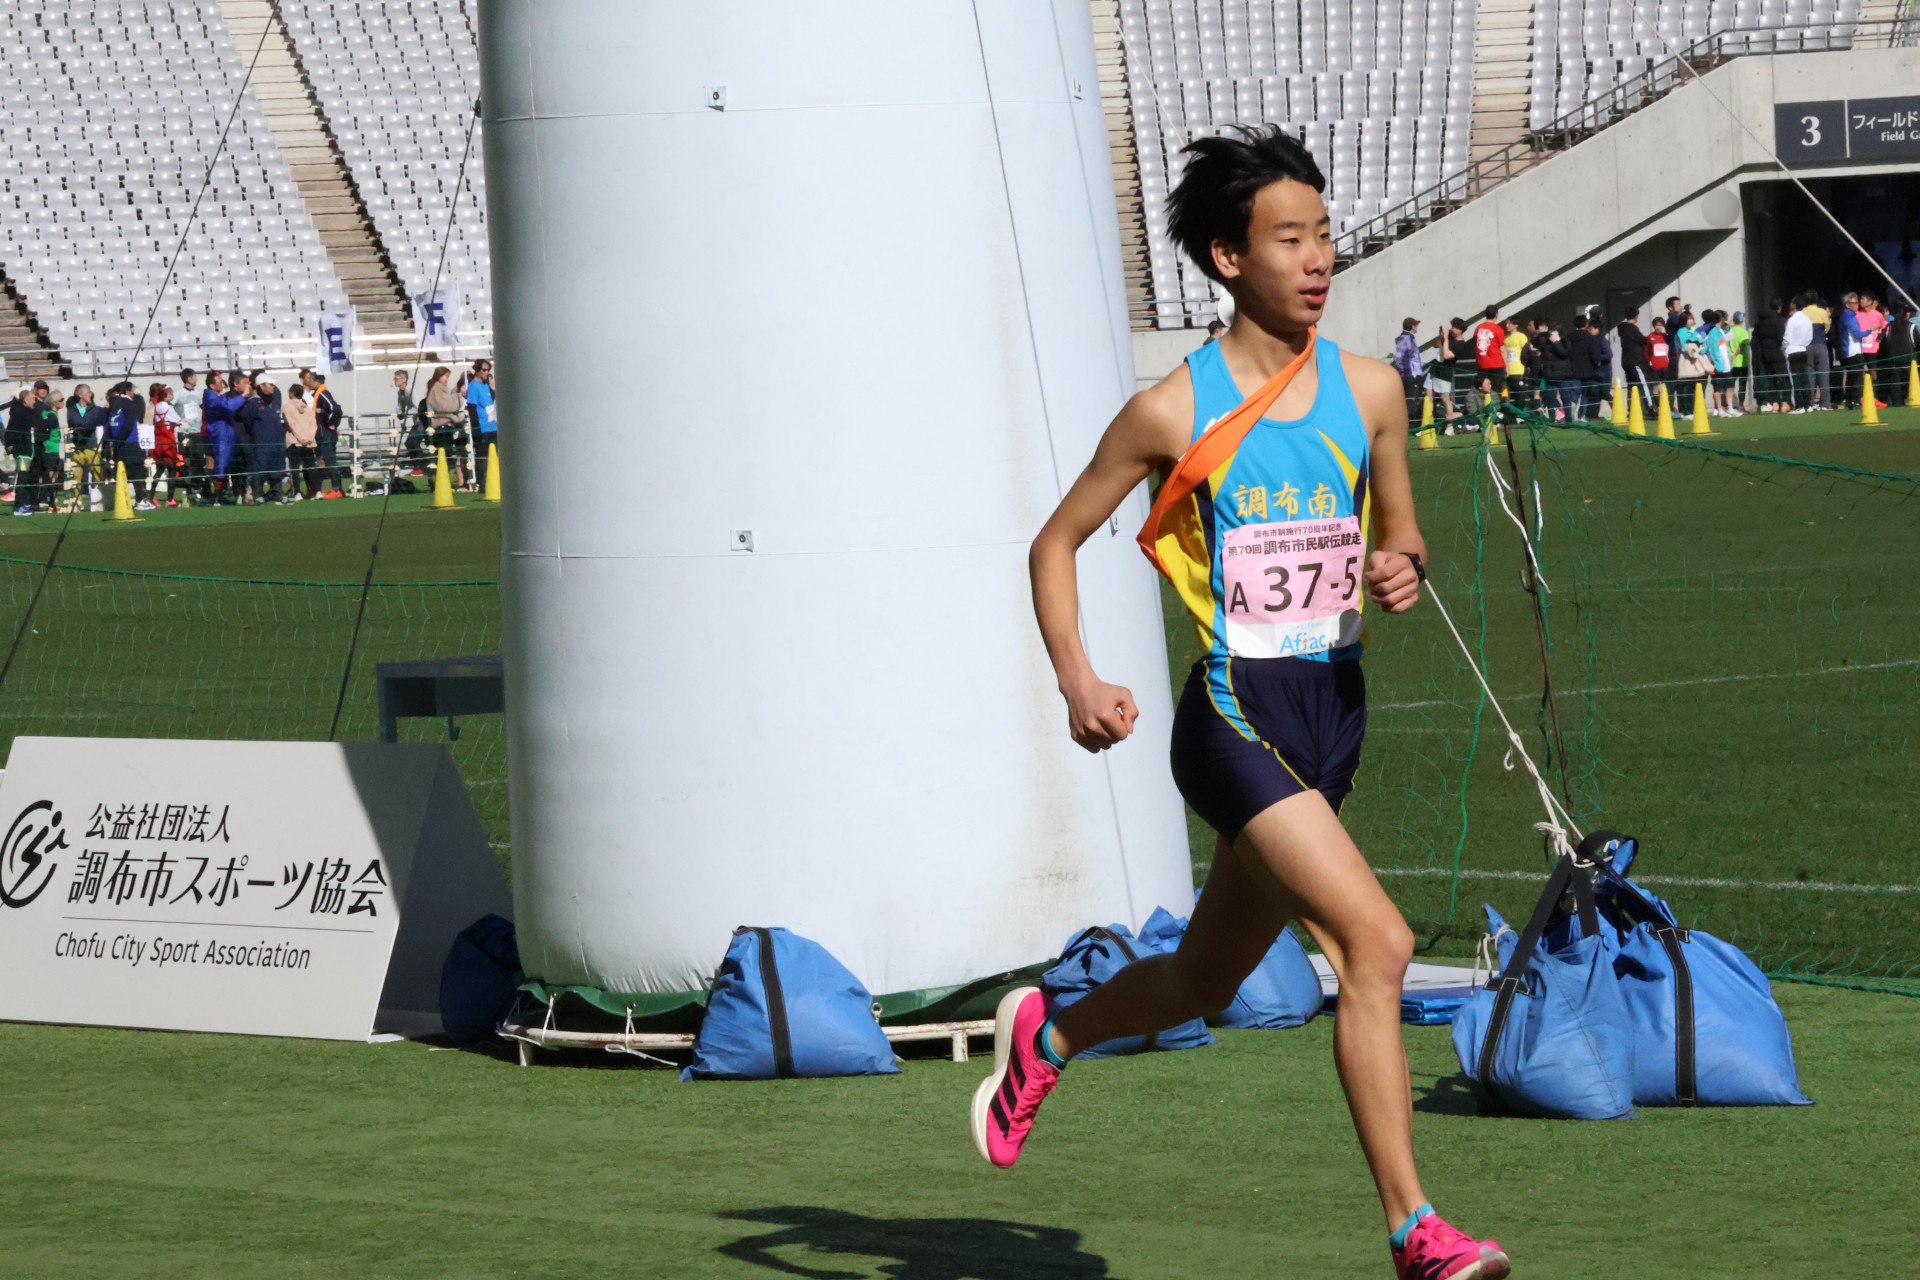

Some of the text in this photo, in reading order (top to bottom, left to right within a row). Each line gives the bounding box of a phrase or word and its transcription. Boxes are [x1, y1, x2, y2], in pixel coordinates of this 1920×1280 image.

[1800, 116, 1821, 146] 3
[1852, 110, 1920, 130] フィールド
[1881, 130, 1920, 141] Field G
[423, 302, 446, 336] F
[325, 327, 347, 361] E
[1231, 481, 1337, 522] 調布南
[1229, 556, 1358, 613] A 37-5
[1280, 631, 1327, 653] Aflac
[85, 802, 231, 843] 公益社団法人
[67, 849, 388, 917] 調布市スポーツ協会
[55, 931, 311, 969] Chofu City Sport Association
